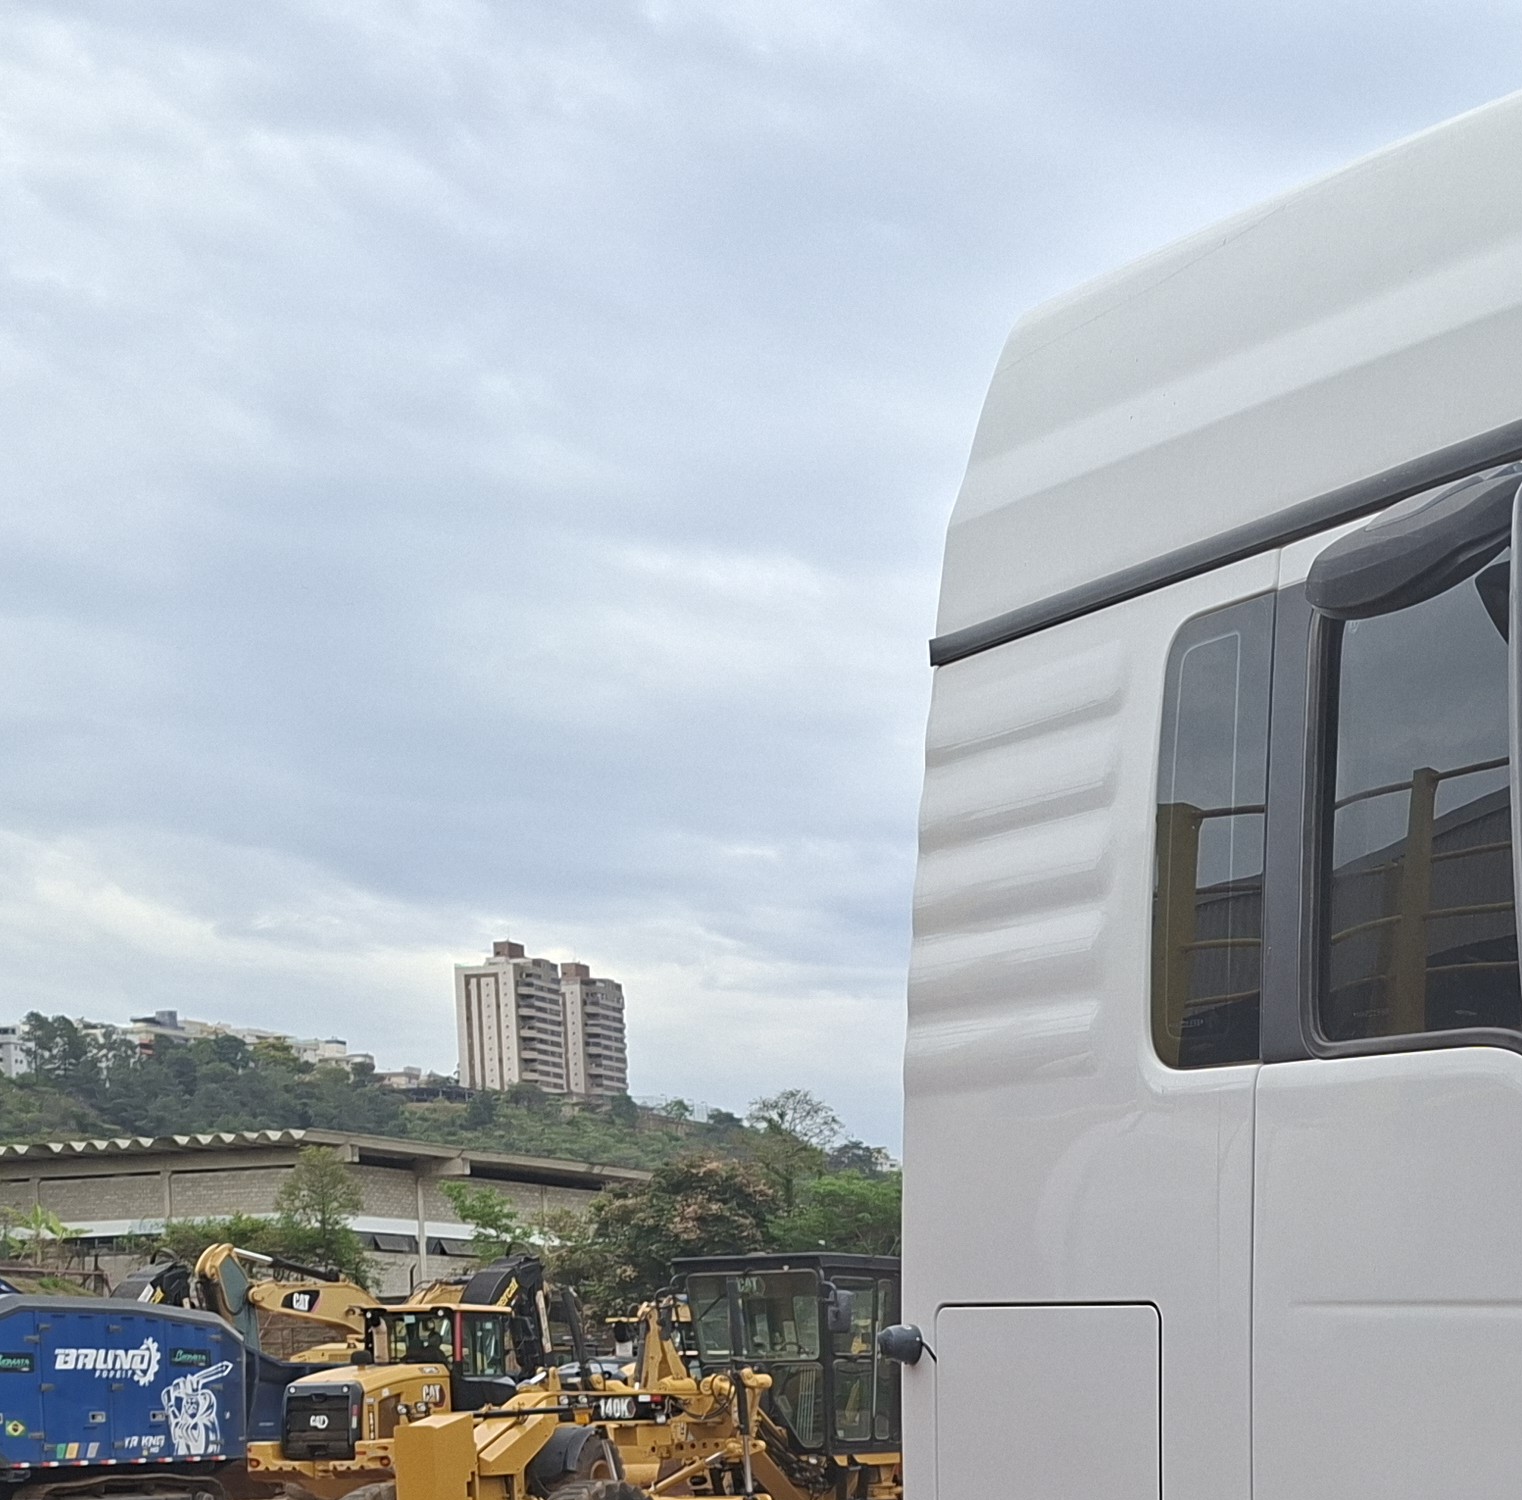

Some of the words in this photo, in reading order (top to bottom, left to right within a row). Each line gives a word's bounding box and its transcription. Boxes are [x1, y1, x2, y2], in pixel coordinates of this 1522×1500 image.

[293, 1292, 310, 1311] CAT
[54, 1348, 150, 1370] BRUNO
[422, 1384, 441, 1402] CAT
[600, 1397, 630, 1419] 140K
